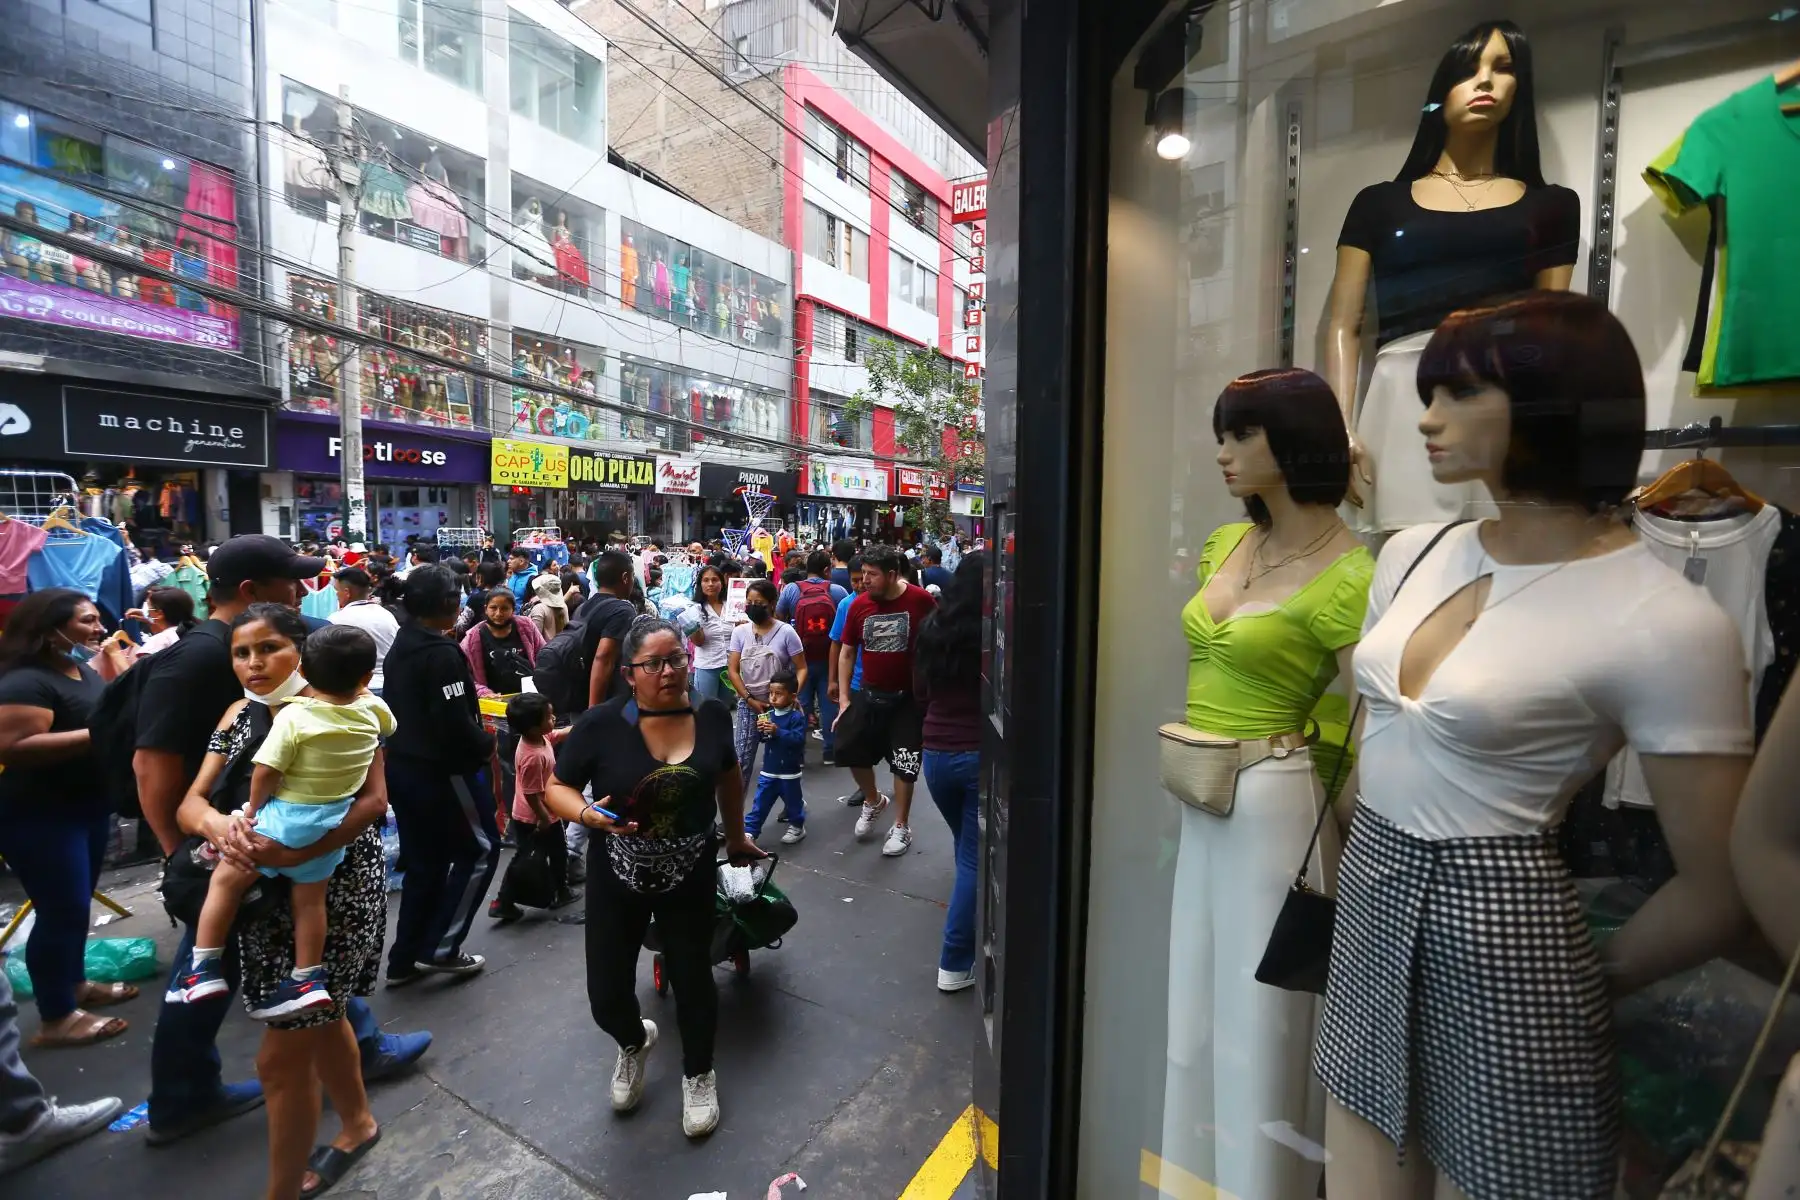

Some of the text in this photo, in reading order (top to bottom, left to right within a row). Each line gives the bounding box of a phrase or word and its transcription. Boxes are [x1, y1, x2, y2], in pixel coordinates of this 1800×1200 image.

[953, 184, 987, 214] GALER
[60, 309, 178, 337] COLLECTION
[98, 413, 245, 440] machine
[328, 436, 447, 466] Fotloose
[499, 470, 563, 481] OUTLET
[570, 455, 654, 486] ORO PLAZA
[738, 471, 769, 485] PARADA
